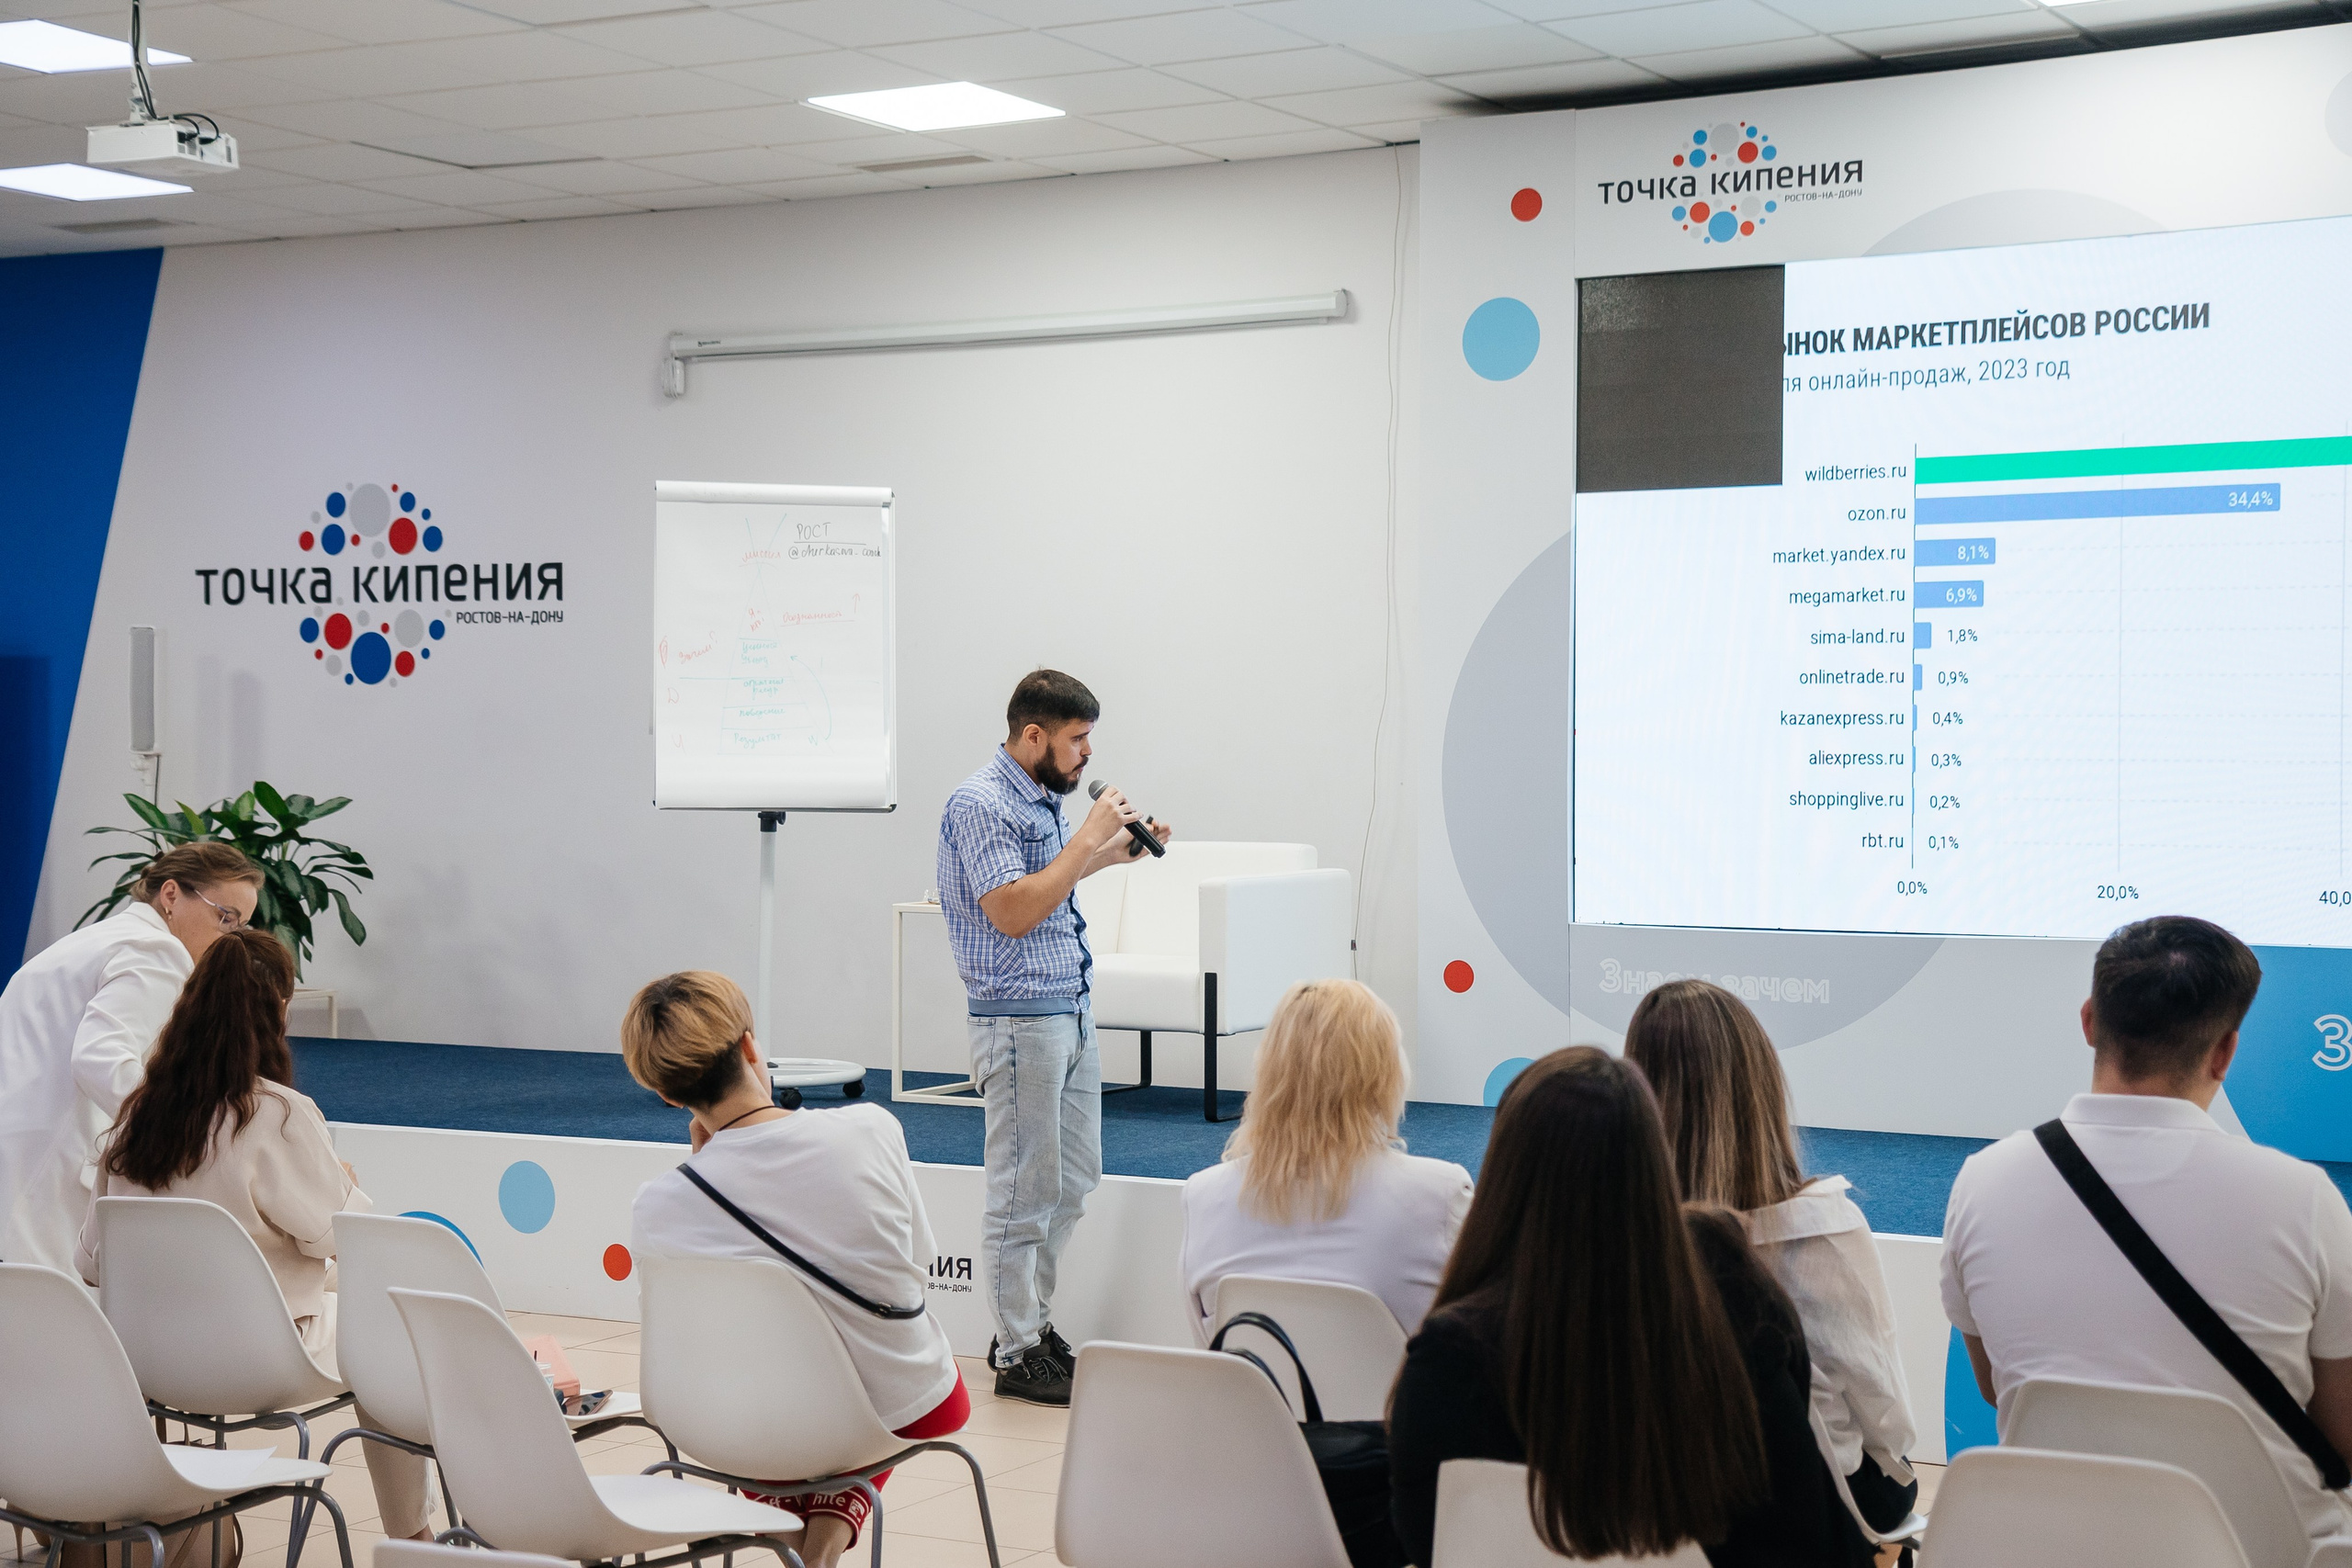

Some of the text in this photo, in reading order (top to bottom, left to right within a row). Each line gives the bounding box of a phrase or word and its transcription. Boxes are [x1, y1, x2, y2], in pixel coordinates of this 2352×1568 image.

[1784, 187, 1863, 203] РОСТОВ-НА-ДОНУ
[1852, 309, 2086, 353] МАРКЕТПЛЕЙСОВ
[2094, 301, 2211, 337] РОССИИ
[1808, 366, 1973, 392] онлайн-продаж,
[1978, 357, 2029, 382] 2023
[2035, 360, 2071, 380] год
[1804, 465, 1906, 481] wildberries.ru
[2227, 491, 2274, 510] 34,4%
[1848, 508, 1906, 522] ozon.ru
[797, 522, 831, 540] РОСТ
[1772, 546, 1905, 566] market.yandex.ru
[1957, 545, 1990, 562] 8,1%
[1789, 587, 1905, 608] megamarket.ru
[1945, 587, 1978, 605] 6,9%
[457, 610, 564, 626] РОСТОВ-НА-ДОНУ
[1811, 627, 1905, 645] sima-land.ru
[1948, 628, 1978, 645] 1,8%
[1799, 668, 1905, 684] onlinetrade.ru
[1938, 671, 1969, 687] 0,9%
[1781, 710, 1905, 729] kazanexpress.ru
[1932, 711, 1963, 728] 0,4%
[1809, 750, 1905, 769] aliexpress.ru
[1930, 753, 1962, 769] 0,3%
[1789, 790, 1904, 810] shoppinglive.ru
[1929, 795, 1961, 811] 0,2%
[1861, 832, 1904, 849] rbt.ru
[1928, 835, 1960, 852] 0,1%
[1897, 880, 1928, 897] 0,0%
[2097, 885, 2140, 901] 20,0%
